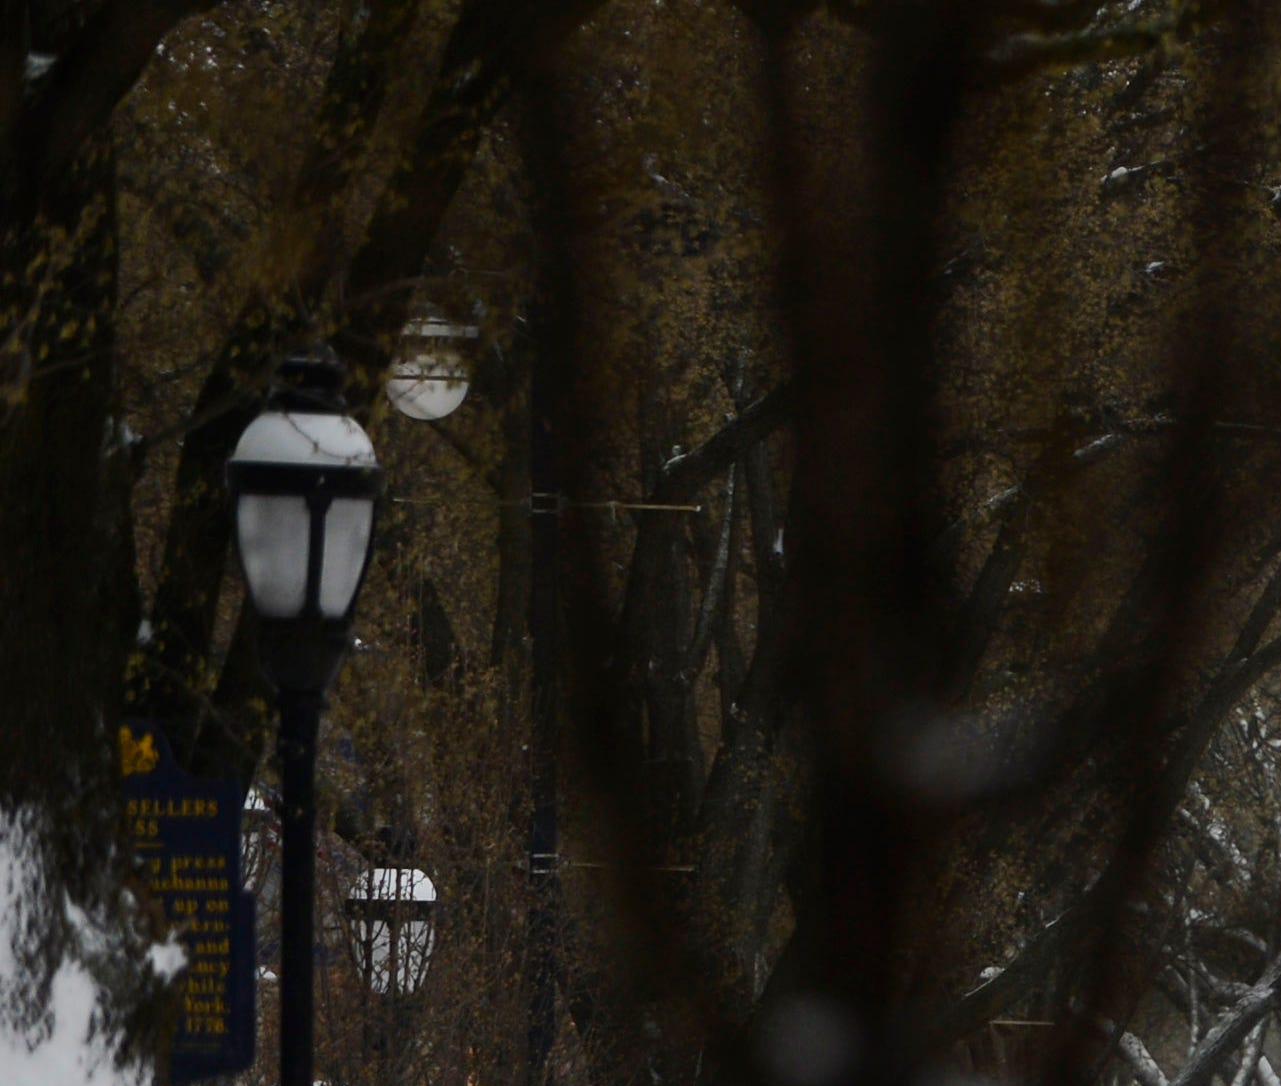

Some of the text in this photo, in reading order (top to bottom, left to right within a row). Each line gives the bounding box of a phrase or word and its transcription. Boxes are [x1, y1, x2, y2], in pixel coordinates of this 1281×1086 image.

[128, 797, 219, 817] SELLERS
[135, 818, 159, 837] SS
[171, 856, 226, 874] press
[195, 937, 231, 955] and
[185, 975, 226, 993] hile
